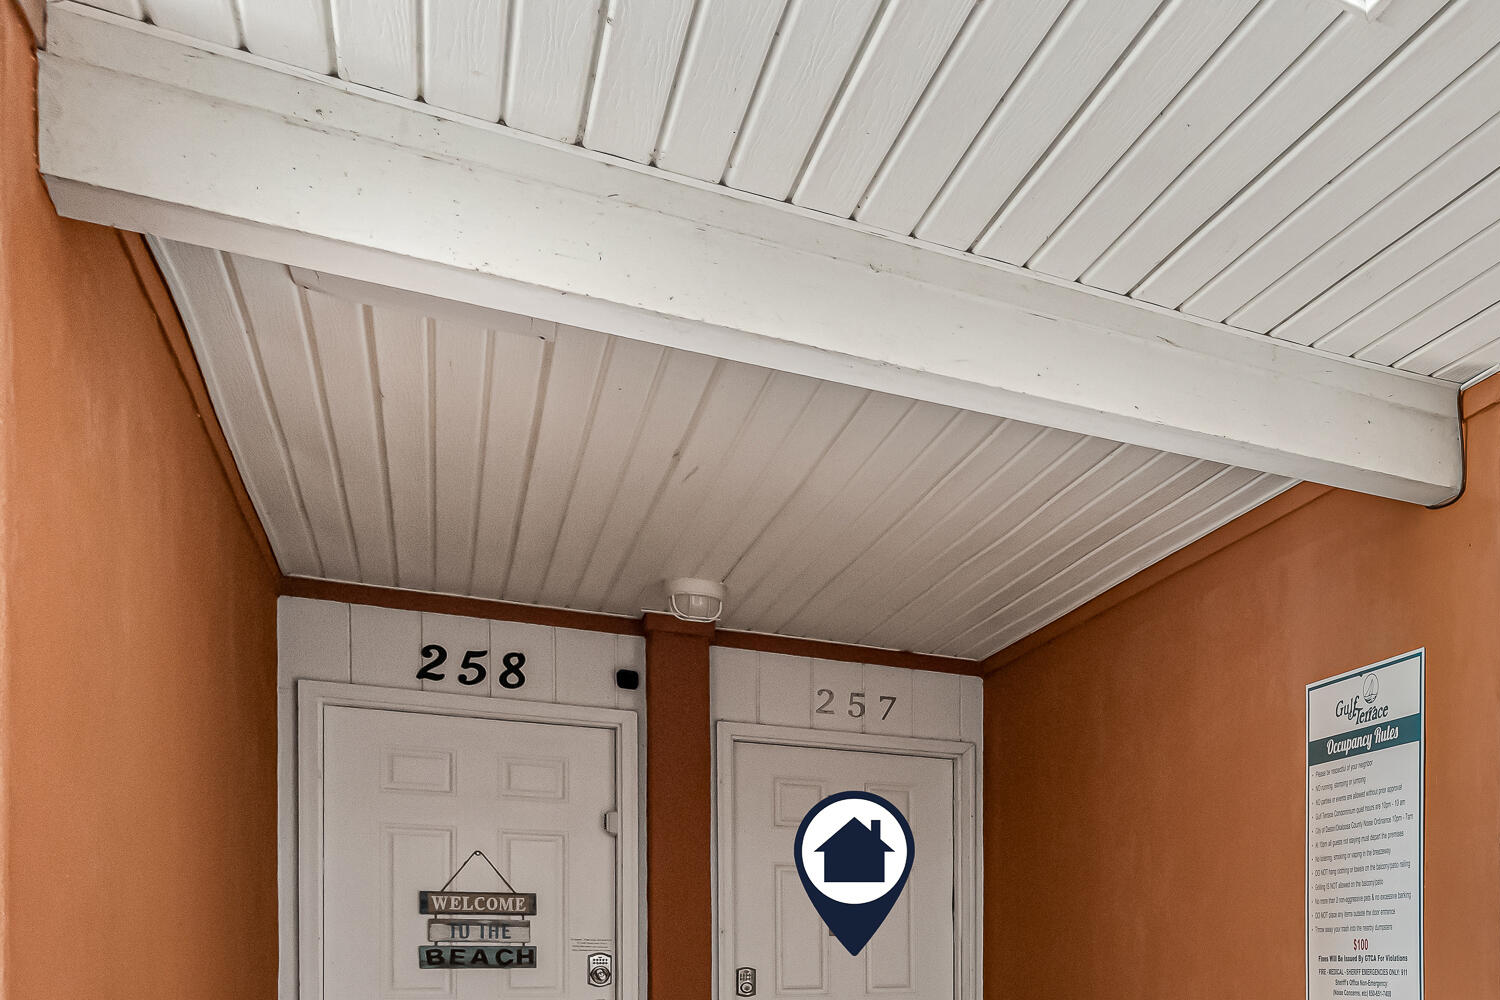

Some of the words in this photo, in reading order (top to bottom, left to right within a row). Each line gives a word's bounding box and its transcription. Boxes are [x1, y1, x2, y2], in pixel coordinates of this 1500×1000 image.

[416, 644, 526, 689] 258
[816, 689, 896, 720] 257
[1335, 695, 1360, 720] Gulf
[1355, 705, 1389, 725] Terrace
[1326, 733, 1373, 755] Occupancy
[1374, 725, 1399, 744] Rules
[431, 895, 526, 912] WELCOME
[450, 923, 470, 939] TO
[479, 923, 511, 939] THE
[1353, 939, 1368, 950] $100
[425, 948, 535, 967] BEACH
